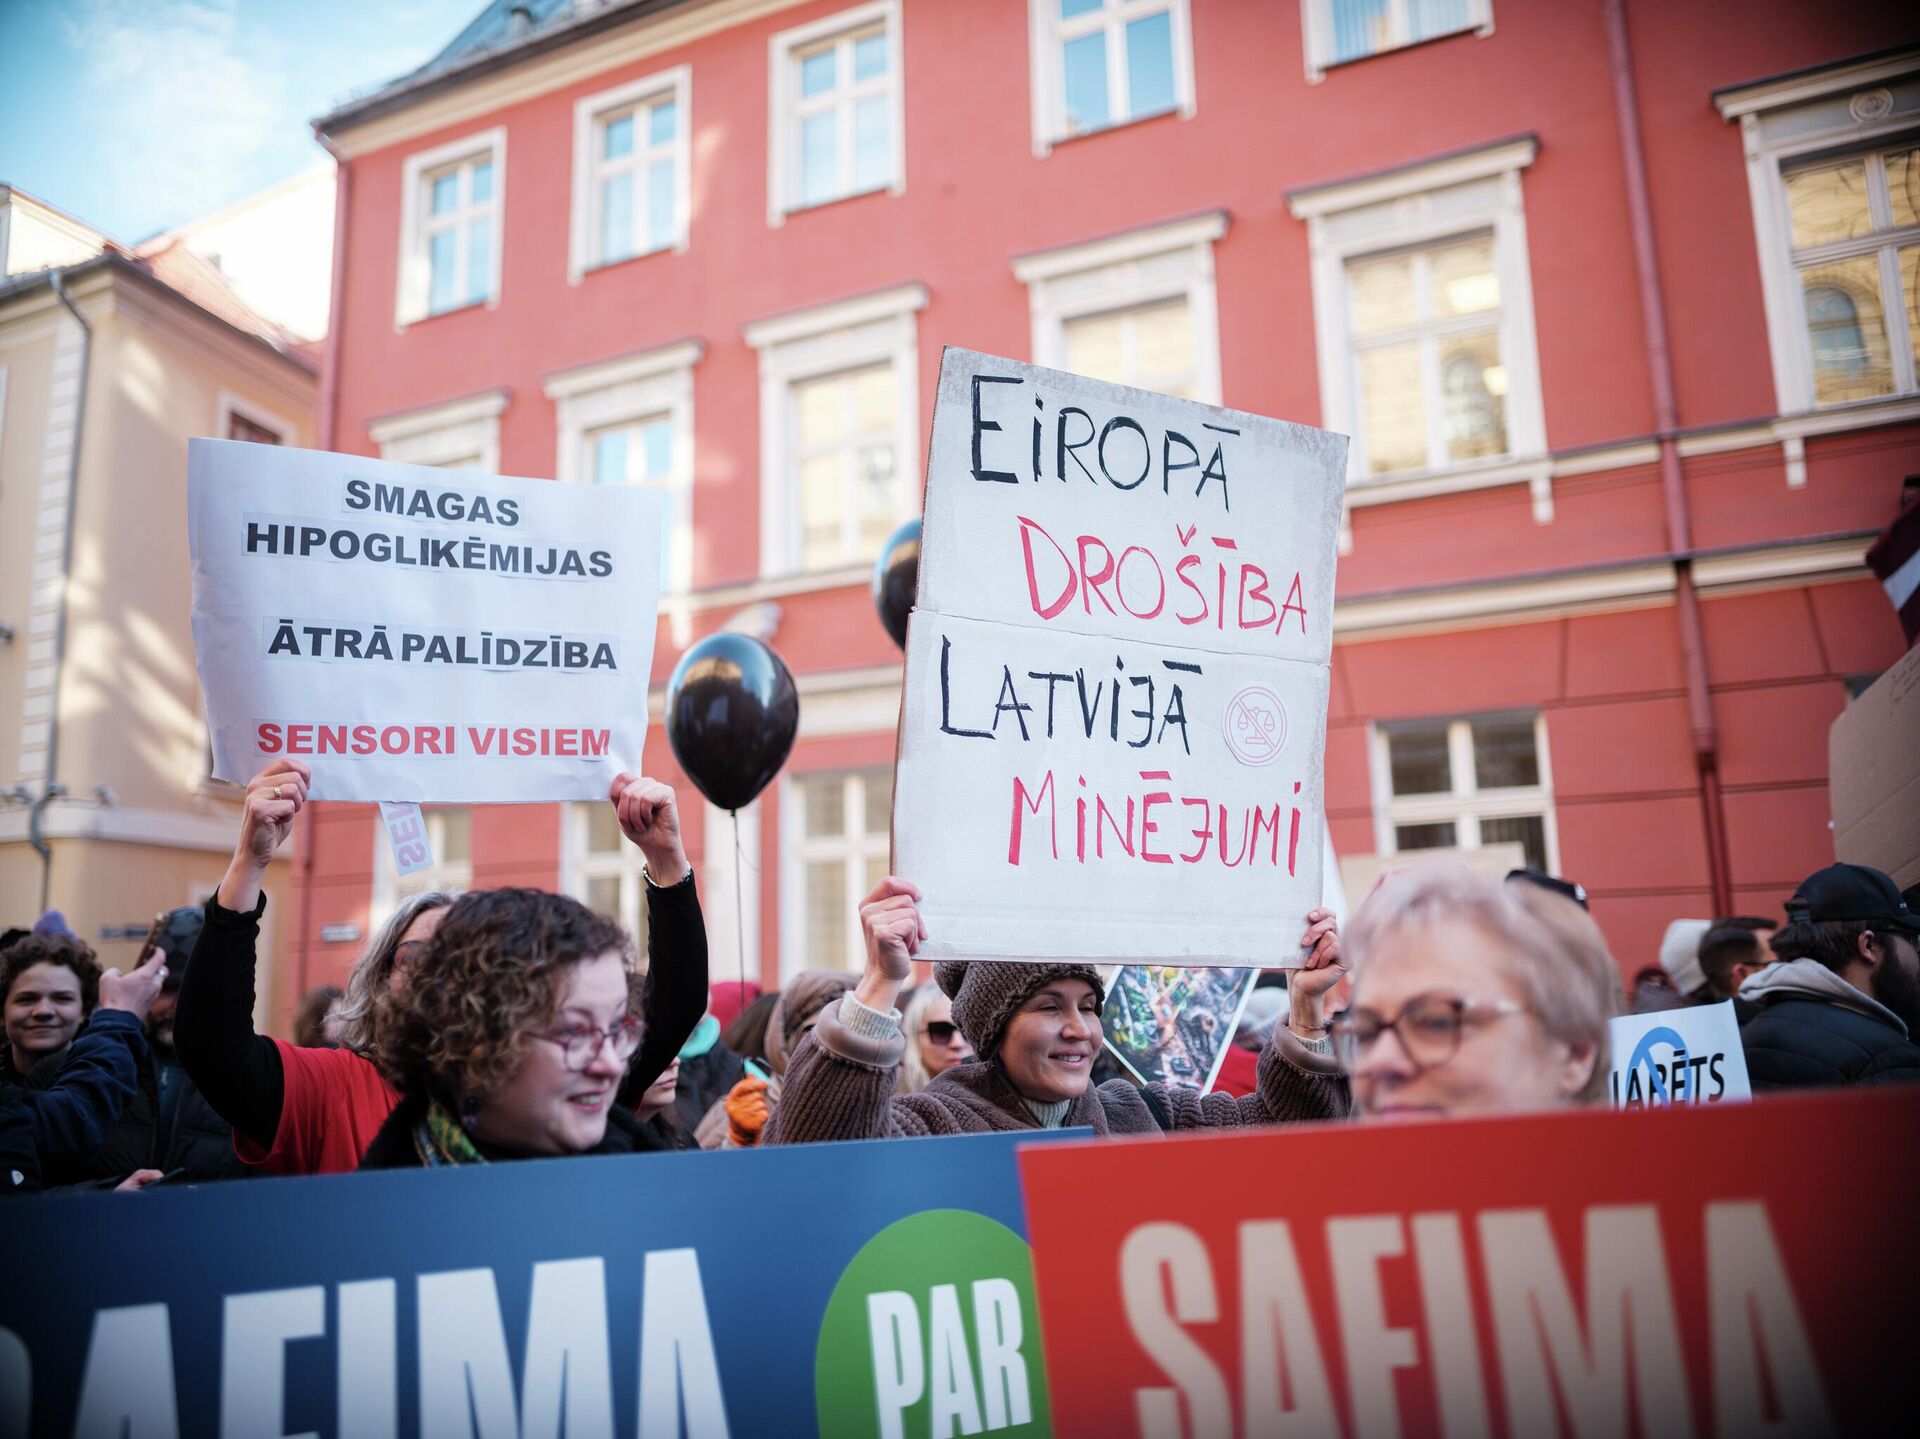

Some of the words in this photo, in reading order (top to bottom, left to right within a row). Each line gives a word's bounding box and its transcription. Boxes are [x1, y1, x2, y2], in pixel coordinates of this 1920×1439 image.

[345, 479, 520, 527] SMAGAS
[246, 522, 614, 577] HIPOGLIKĒMIJAS
[1016, 515, 1308, 635] DROŠĪBA
[268, 618, 394, 661] ĀTRĀ
[400, 631, 618, 670] PALĪDZĪBA
[257, 723, 456, 755] SENSORI
[467, 727, 611, 756] VISIEM
[866, 1277, 1033, 1439] PAR
